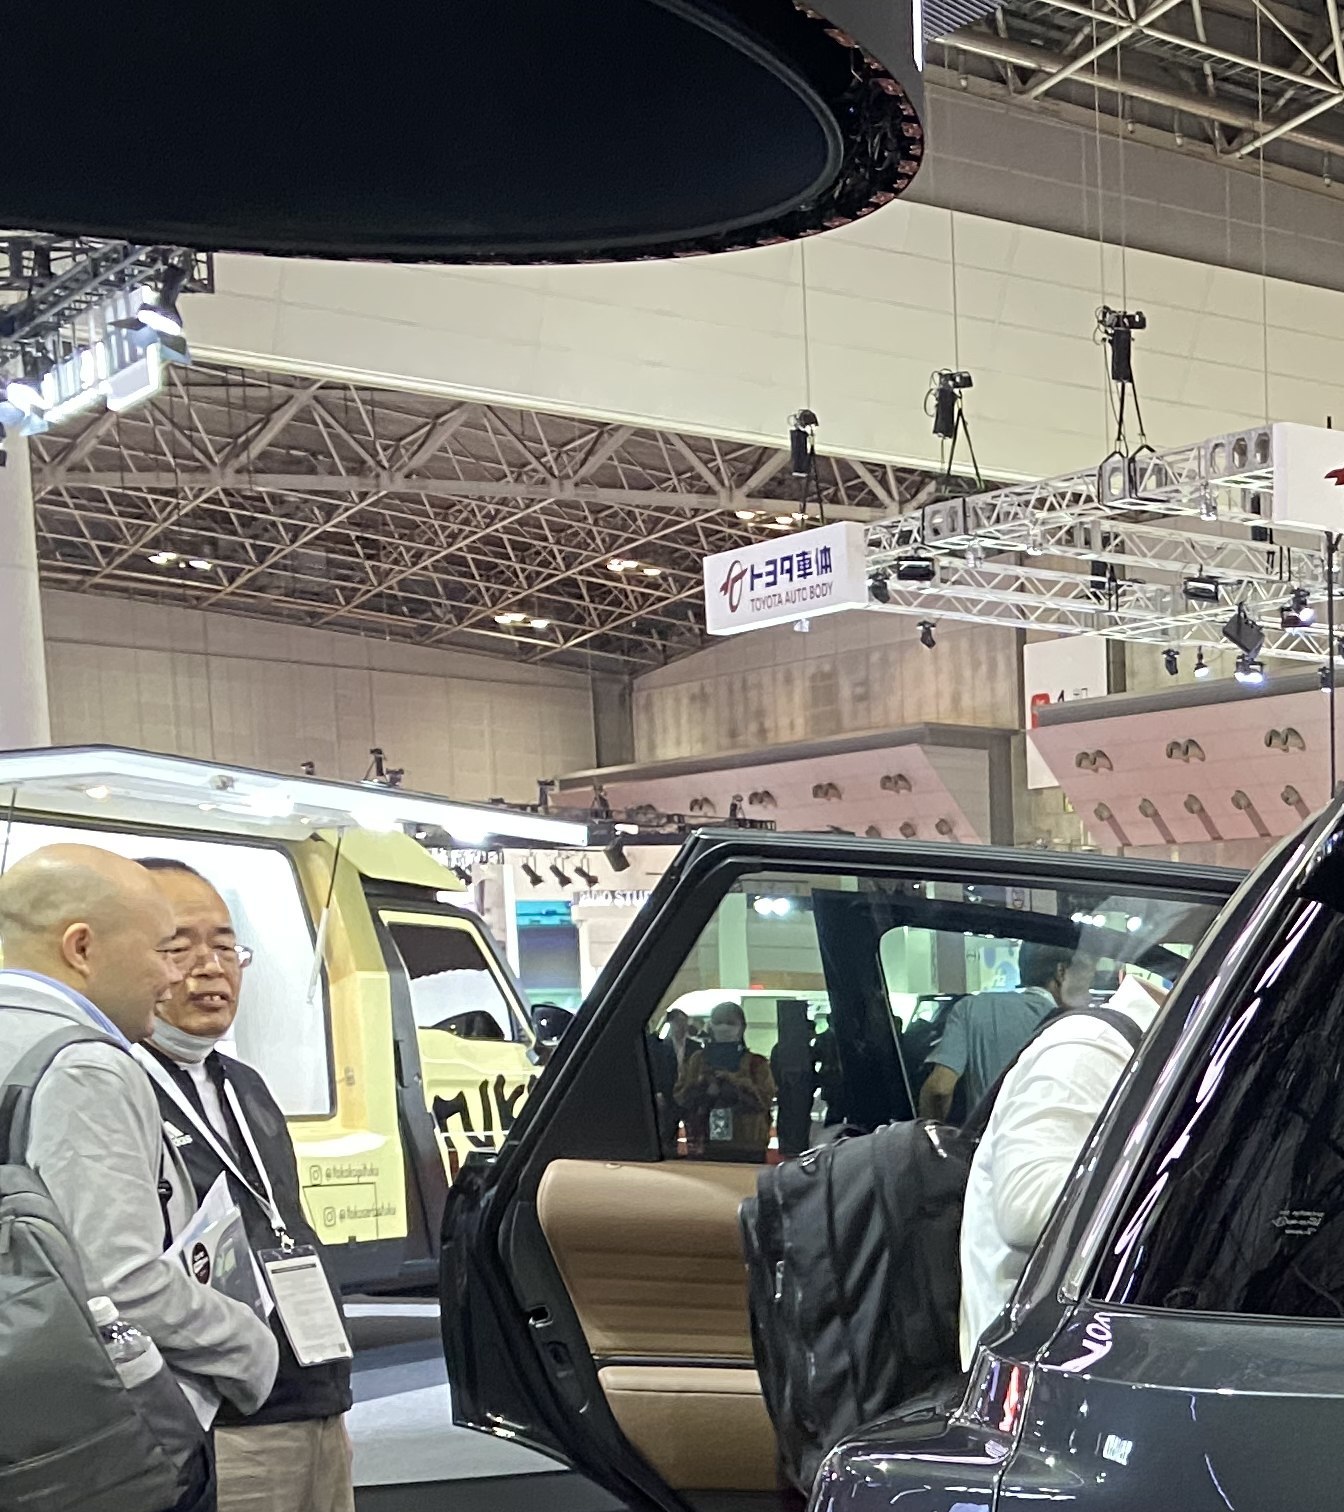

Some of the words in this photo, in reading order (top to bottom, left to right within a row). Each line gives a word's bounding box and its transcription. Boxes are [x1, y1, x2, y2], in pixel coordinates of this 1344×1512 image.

[750, 545, 833, 592] トヨタ車体
[750, 592, 784, 612] TOYOTA
[785, 586, 808, 606] AUTO
[809, 580, 834, 600] BODY
